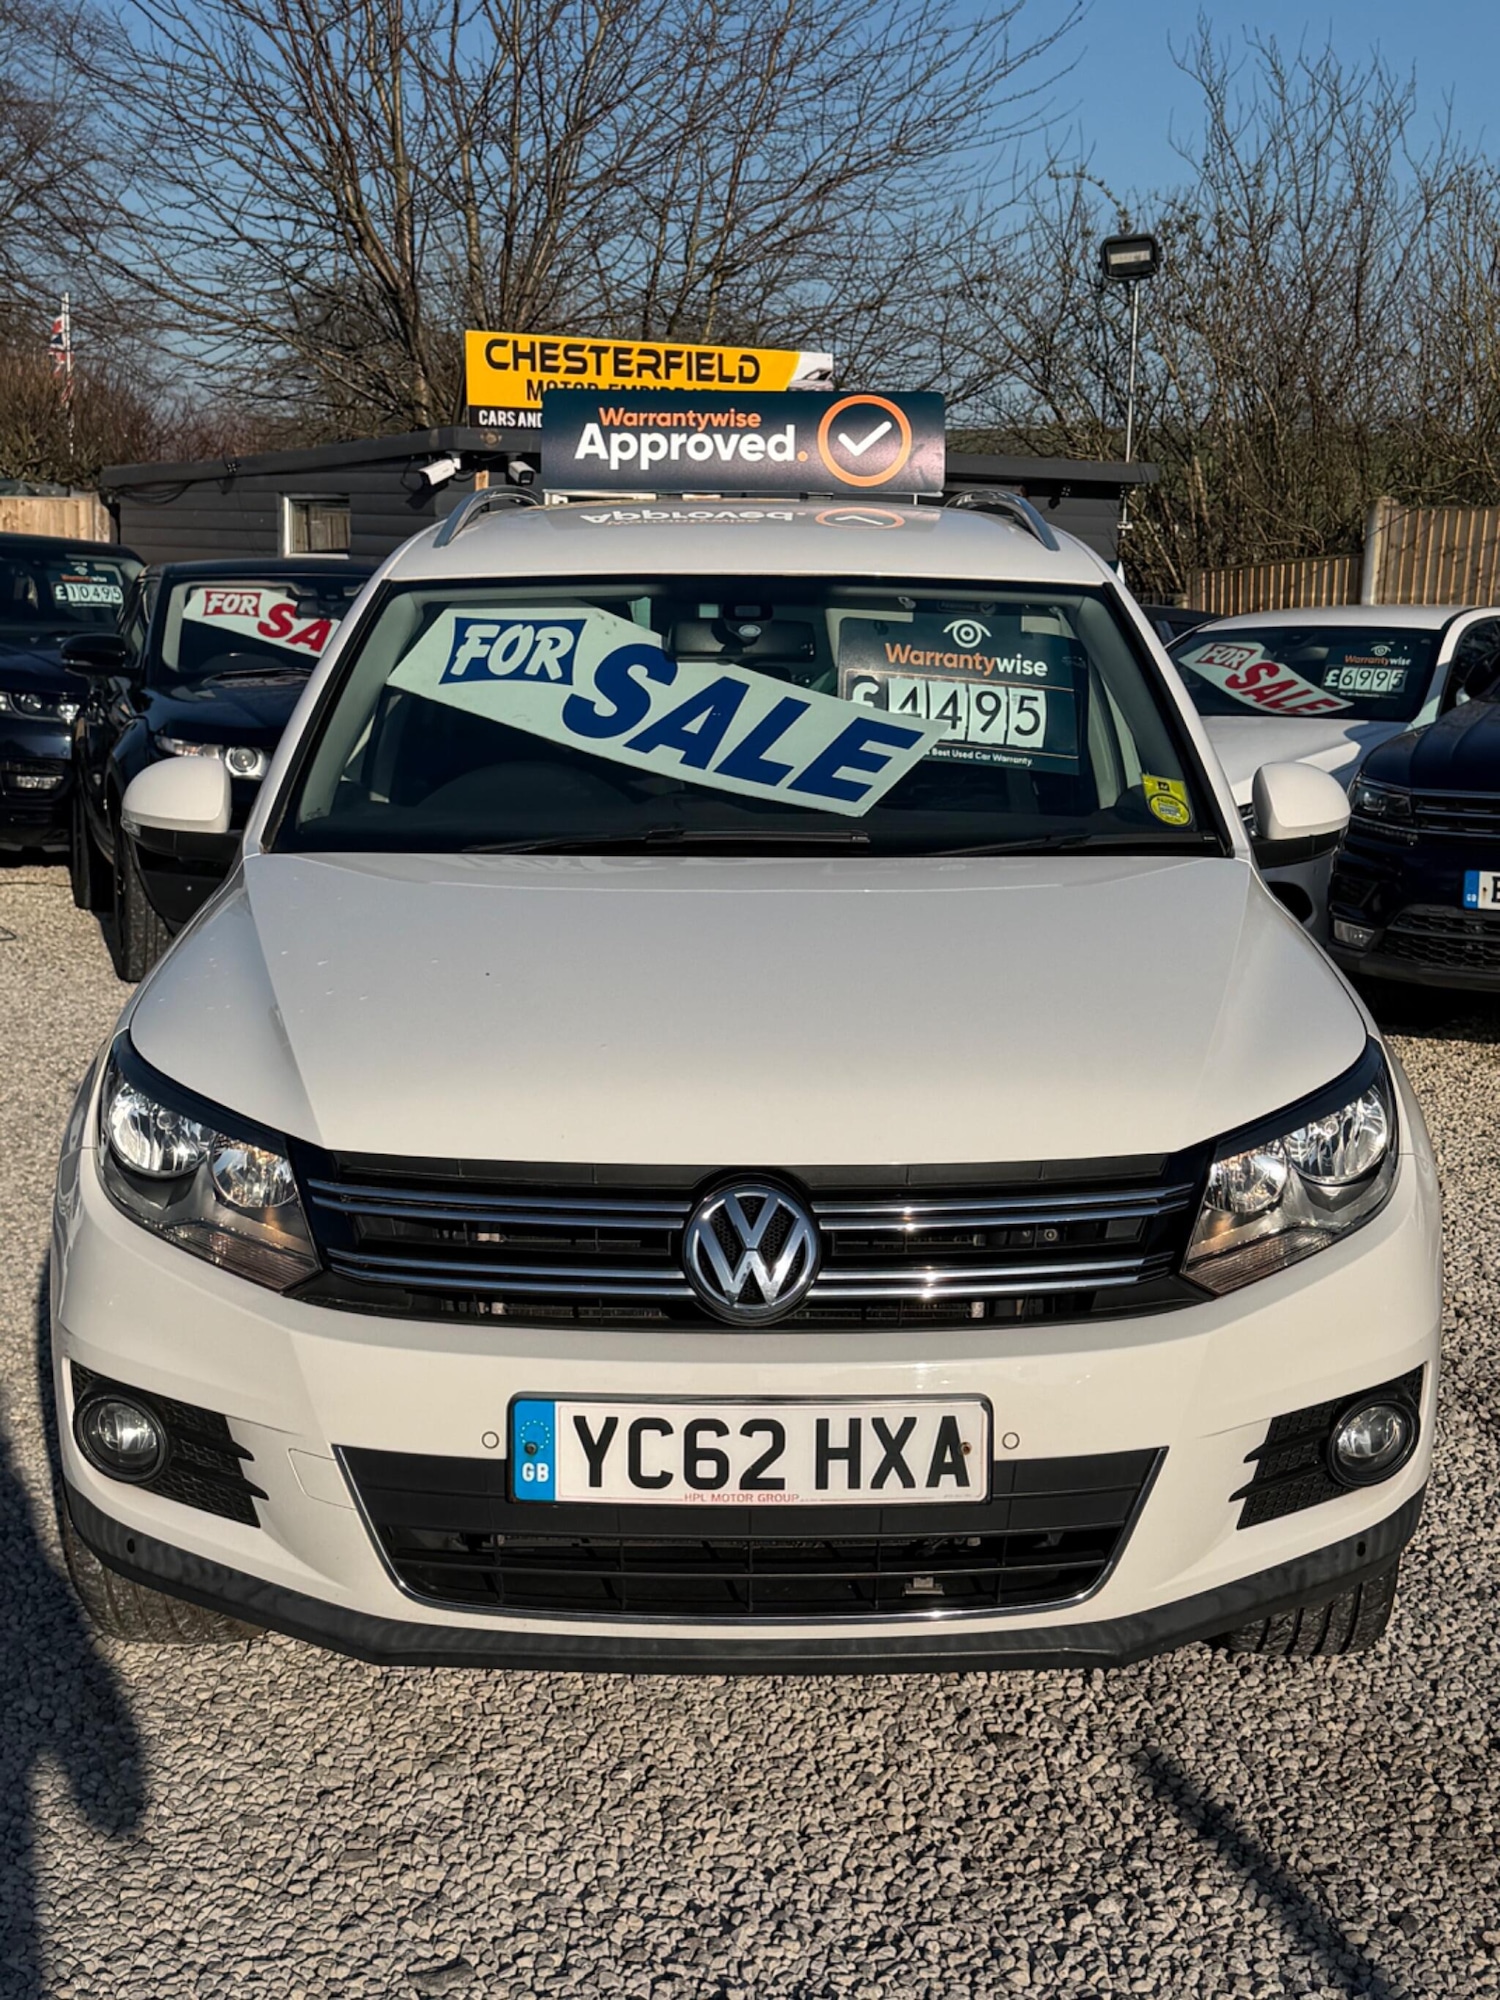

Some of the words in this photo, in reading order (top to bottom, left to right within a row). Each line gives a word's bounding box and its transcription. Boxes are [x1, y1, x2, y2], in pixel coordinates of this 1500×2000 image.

[485, 338, 760, 384] CHESTERFIELD
[478, 409, 516, 427] CARS
[598, 407, 762, 431] Warrantywise
[574, 423, 808, 470] Approved.
[55, 585, 121, 600] £10495
[206, 592, 260, 615] FOR
[257, 602, 333, 653] SA
[885, 643, 1048, 677] Warrantywise
[1200, 645, 1247, 670] FOR
[1225, 662, 1343, 714] SALE
[1324, 668, 1405, 689] £6995
[449, 622, 576, 682] FOR
[562, 643, 925, 803] SALE
[952, 749, 974, 760] Used
[572, 1415, 786, 1490] YC62
[815, 1415, 971, 1490] HXA
[521, 1462, 550, 1484] GB
[684, 1493, 707, 1503] HPL
[711, 1493, 754, 1503] MOTOR
[757, 1493, 800, 1503] GROUP
